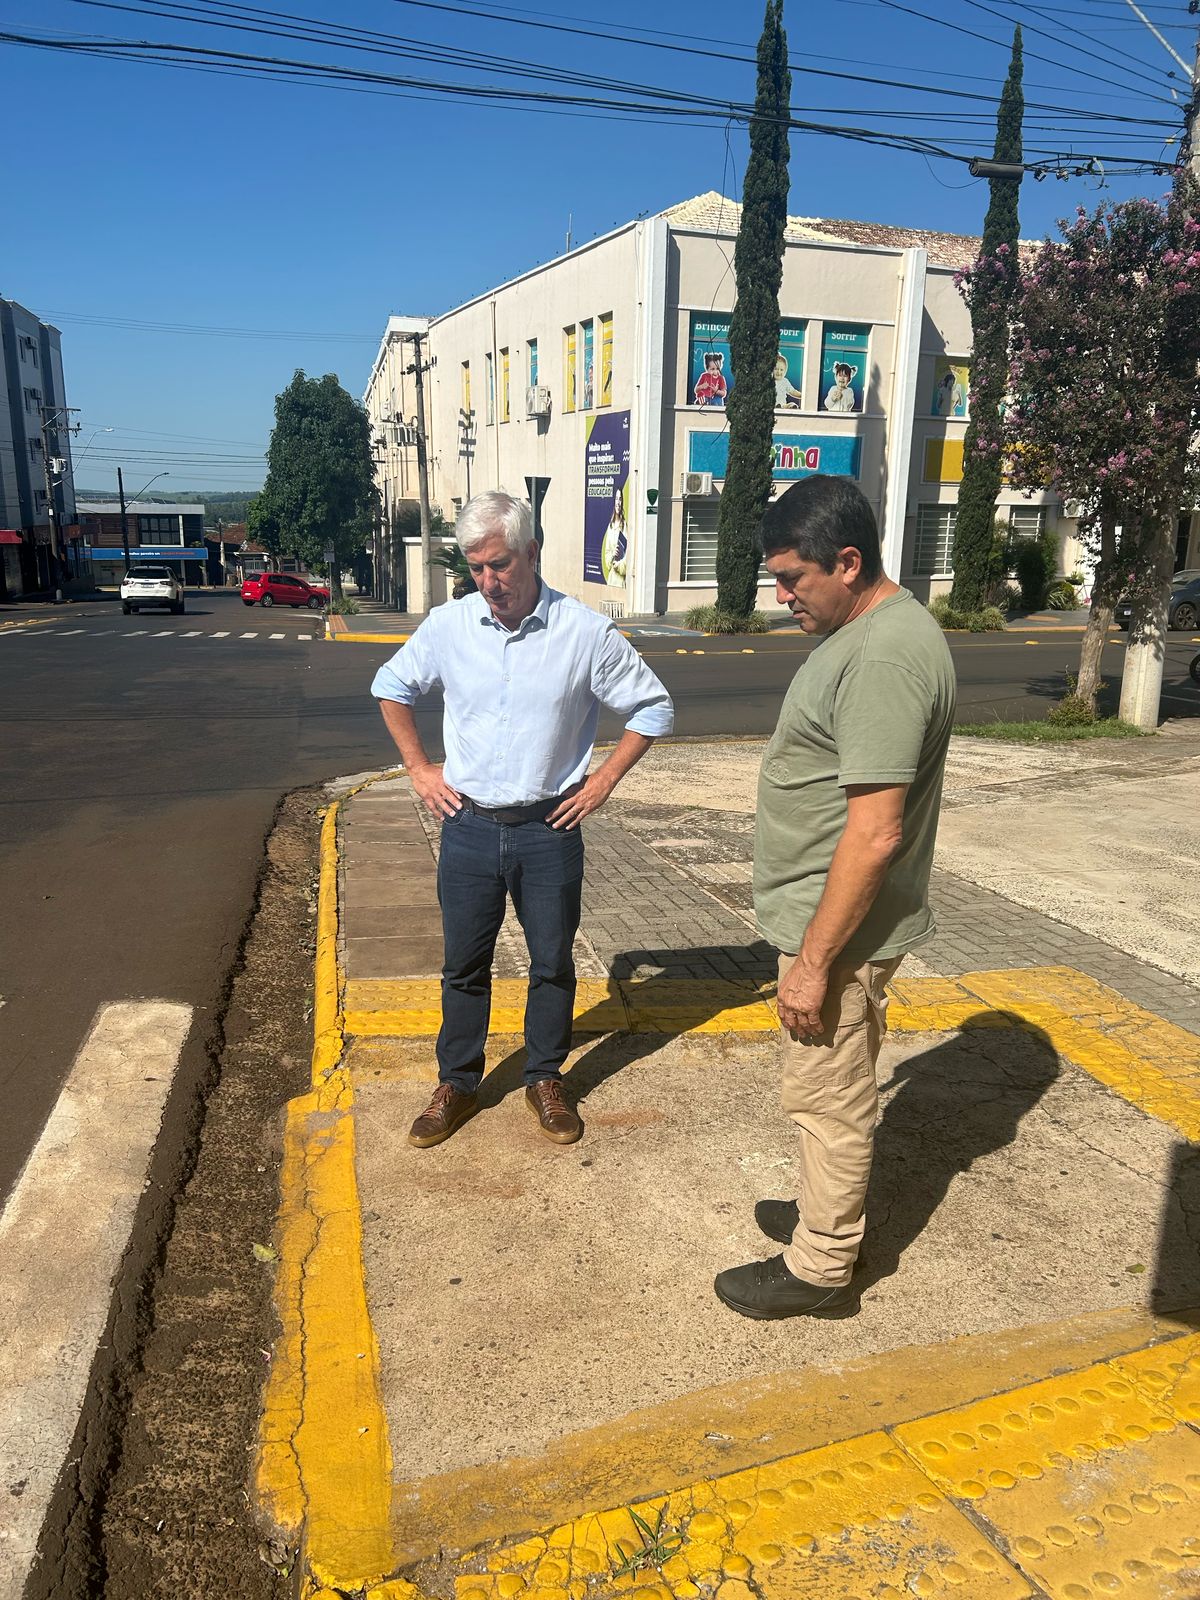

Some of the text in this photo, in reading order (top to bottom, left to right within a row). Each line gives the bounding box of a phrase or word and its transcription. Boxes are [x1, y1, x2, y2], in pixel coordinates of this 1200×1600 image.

[831, 330, 857, 341] Sorrir
[588, 441, 611, 451] Muito mais
[588, 456, 597, 464] que
[589, 465, 620, 474] TRANSFORMAR
[588, 476, 614, 487] pessoas pela
